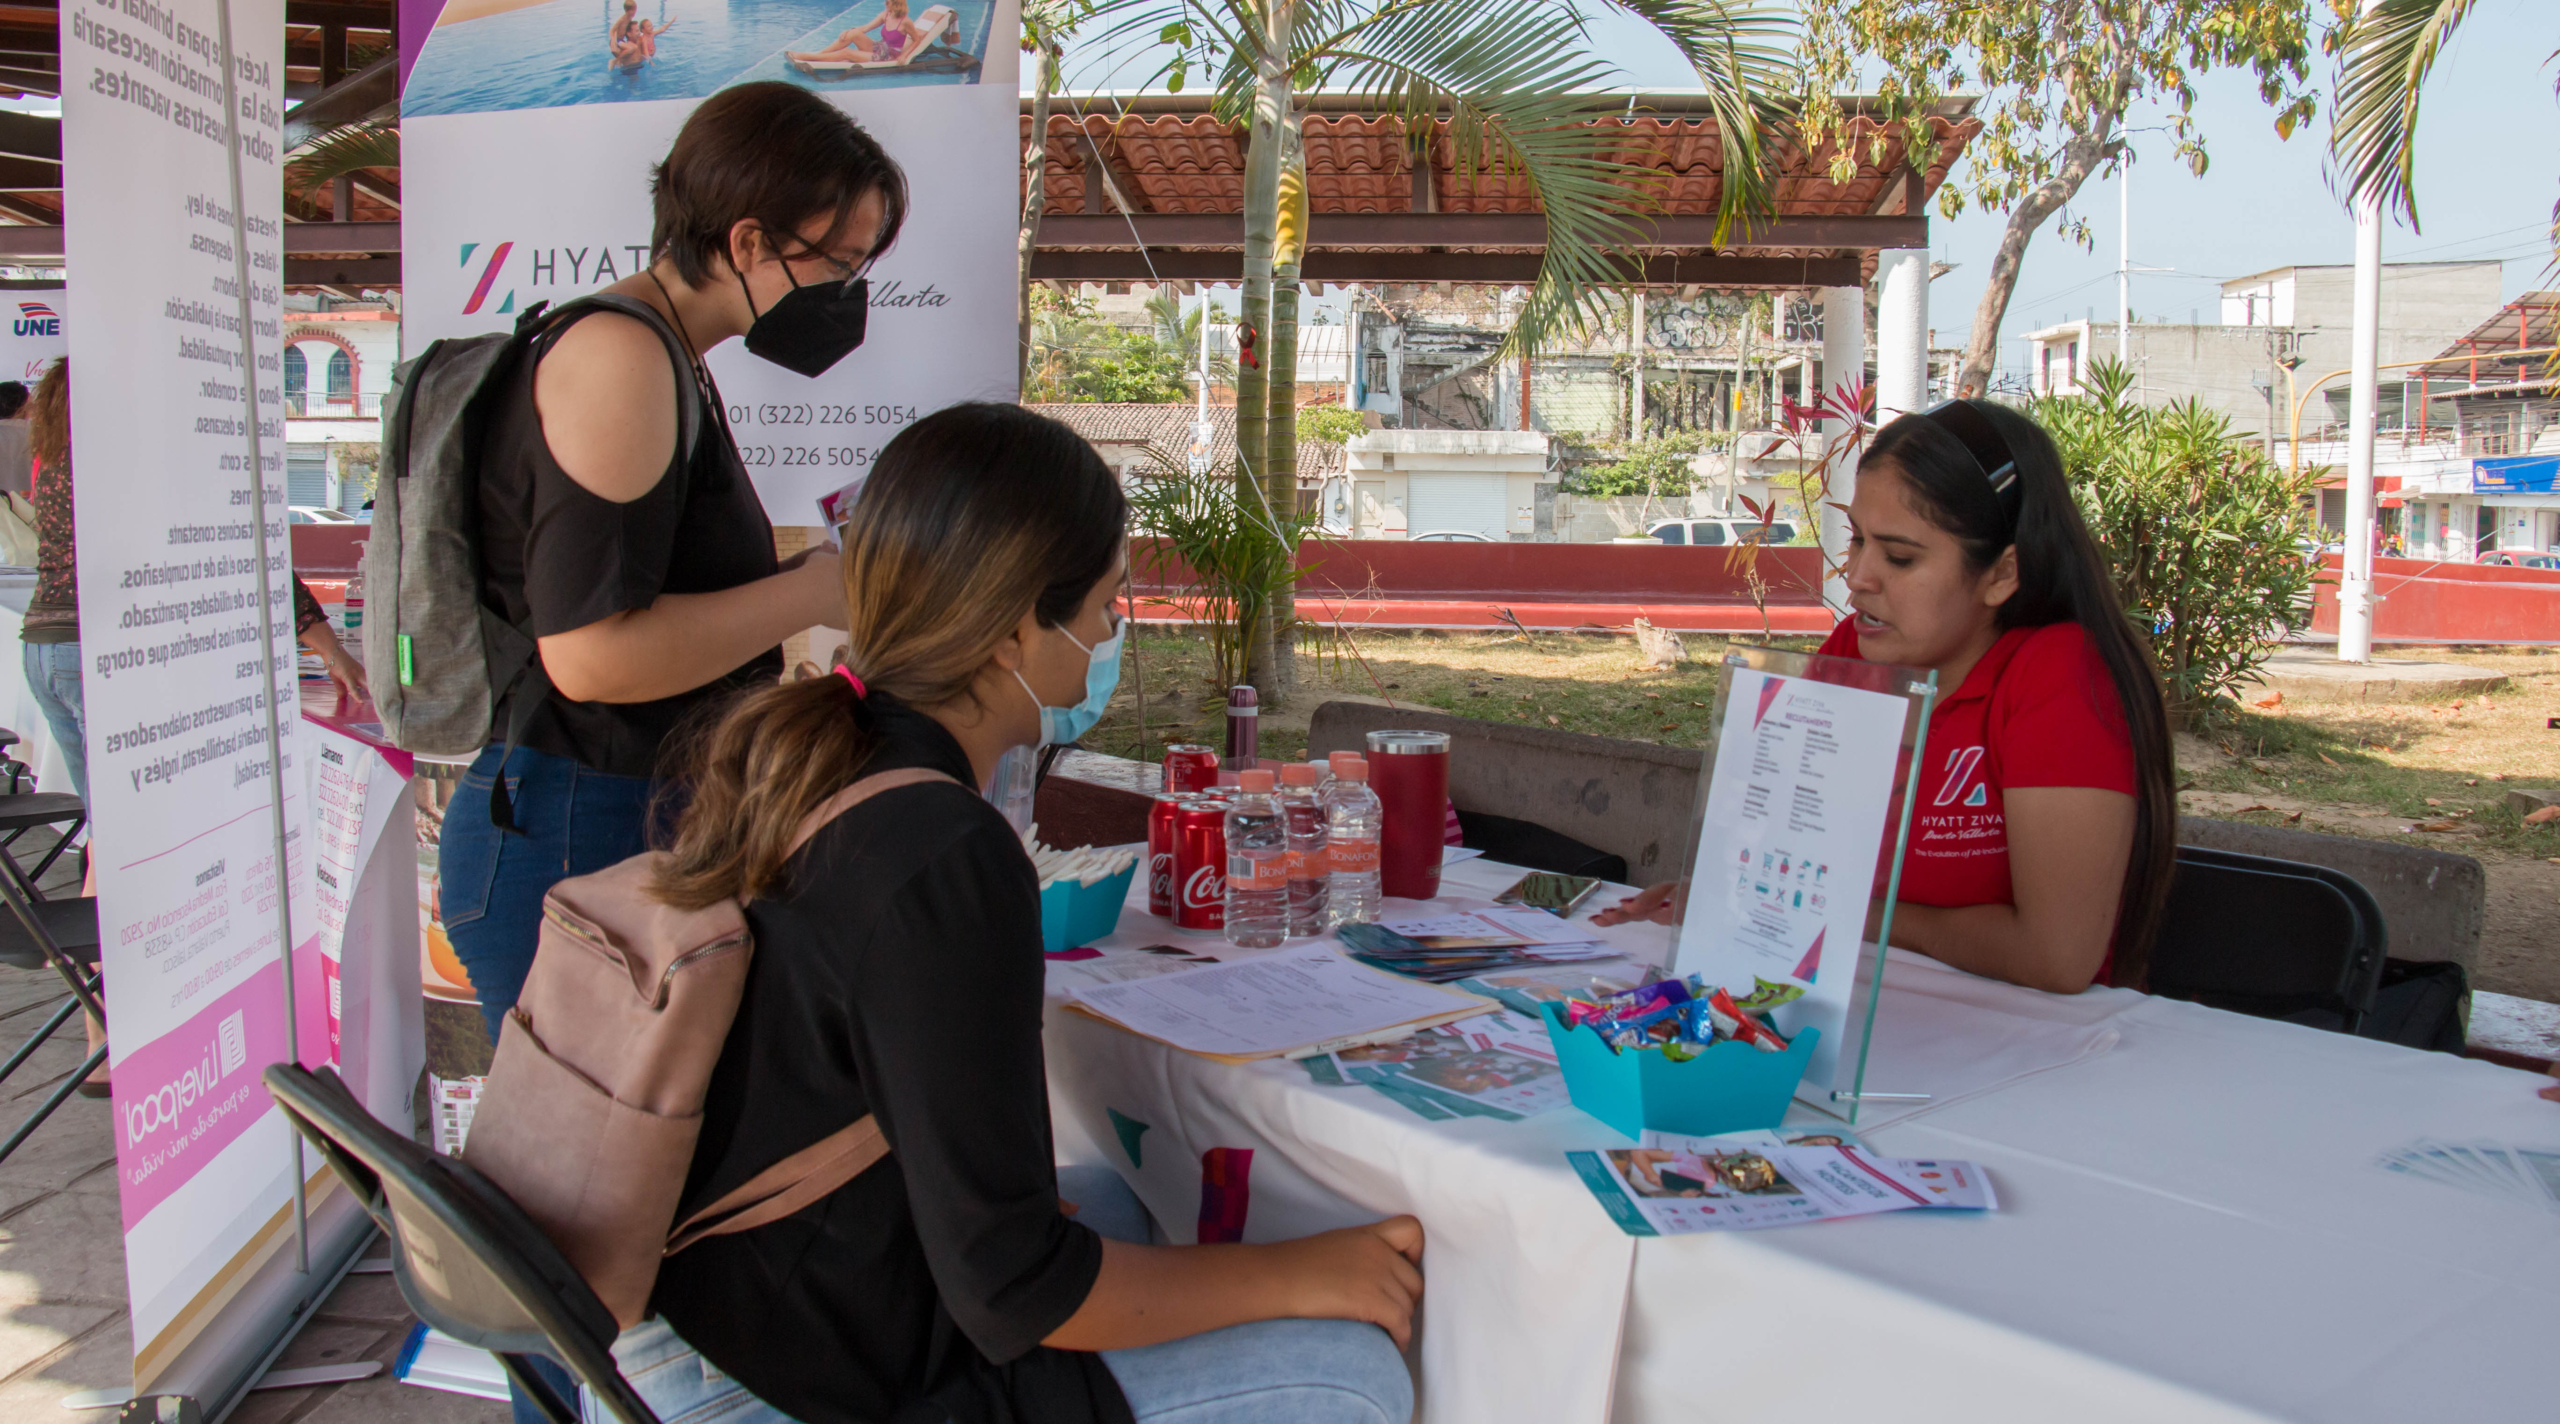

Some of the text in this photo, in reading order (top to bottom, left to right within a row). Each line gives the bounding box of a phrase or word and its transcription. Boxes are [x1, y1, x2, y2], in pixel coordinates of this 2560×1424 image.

[533, 246, 650, 286] HYAT
[867, 281, 951, 308] llarta
[14, 319, 60, 336] UNE
[730, 403, 918, 426] 01 (322) 226 5054
[738, 444, 880, 467] 22) 226 5054
[1922, 815, 2004, 827] HYATT ZIVA
